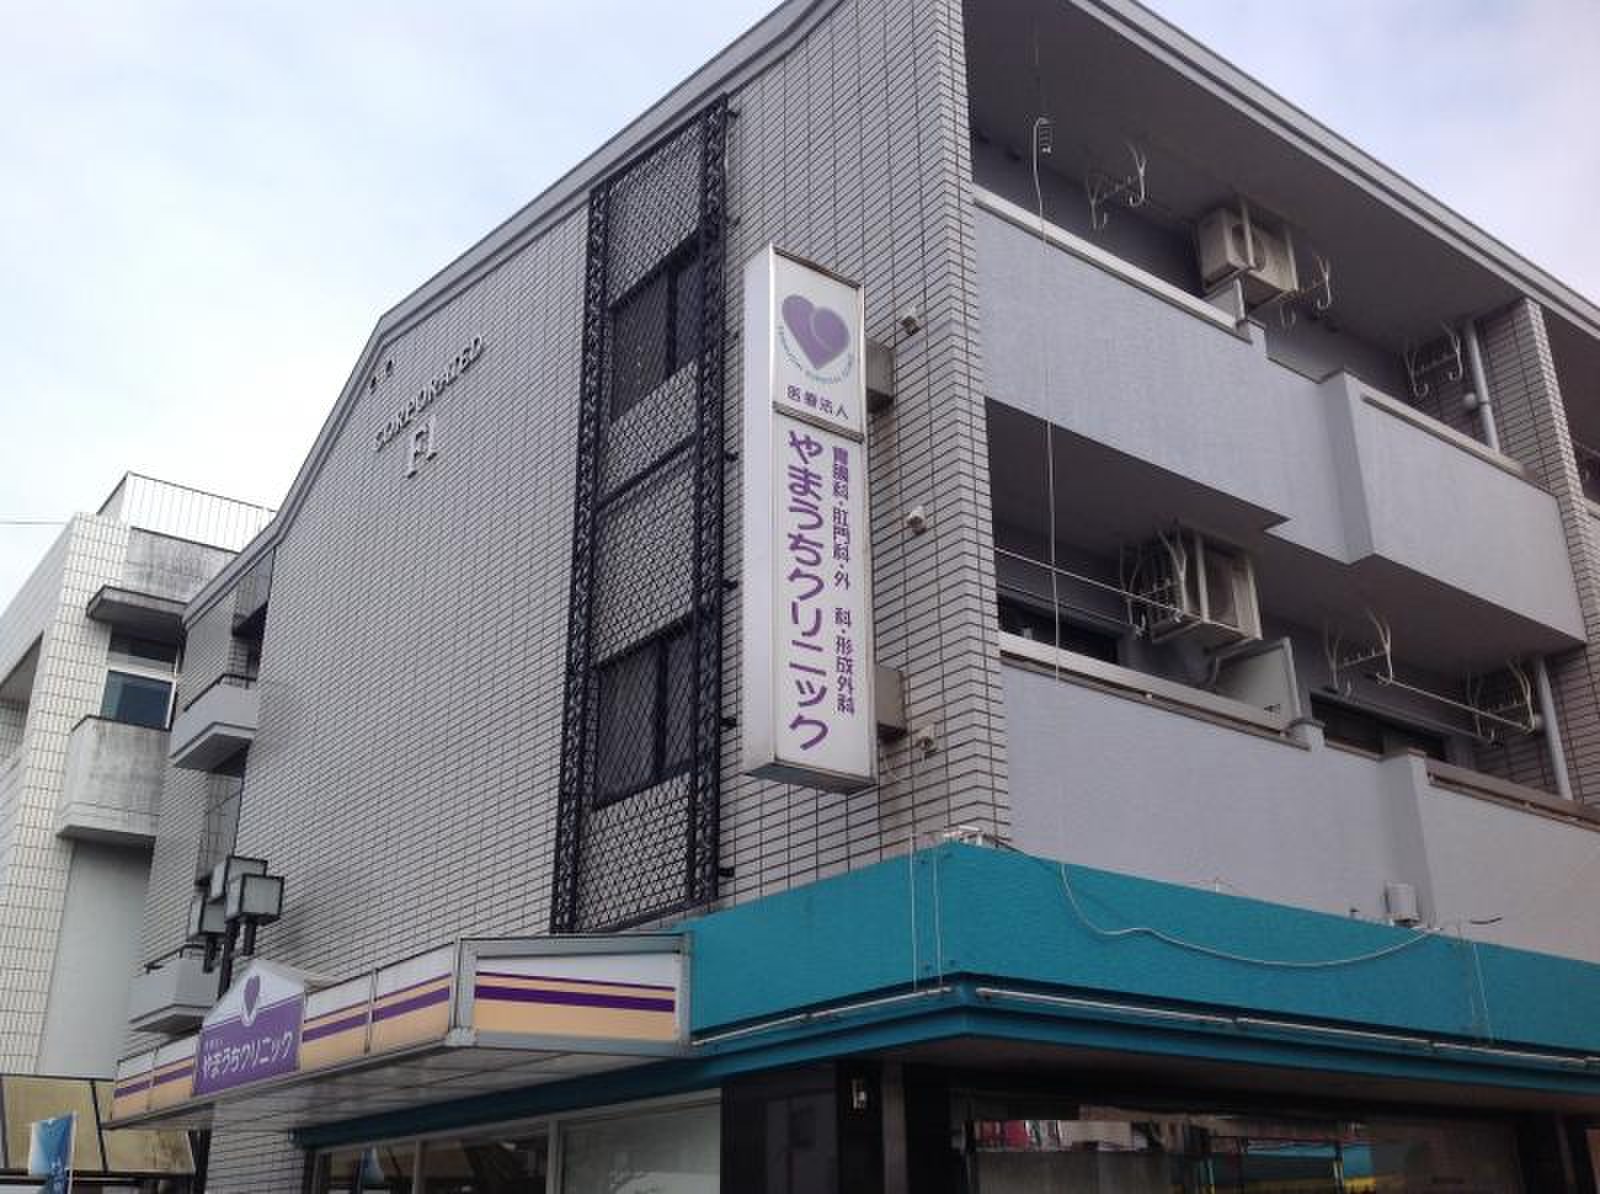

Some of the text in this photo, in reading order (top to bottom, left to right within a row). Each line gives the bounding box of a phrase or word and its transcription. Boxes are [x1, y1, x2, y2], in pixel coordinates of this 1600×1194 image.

[788, 429, 829, 751] やまうちクリニック
[202, 1031, 293, 1079] やまうちクリニック
